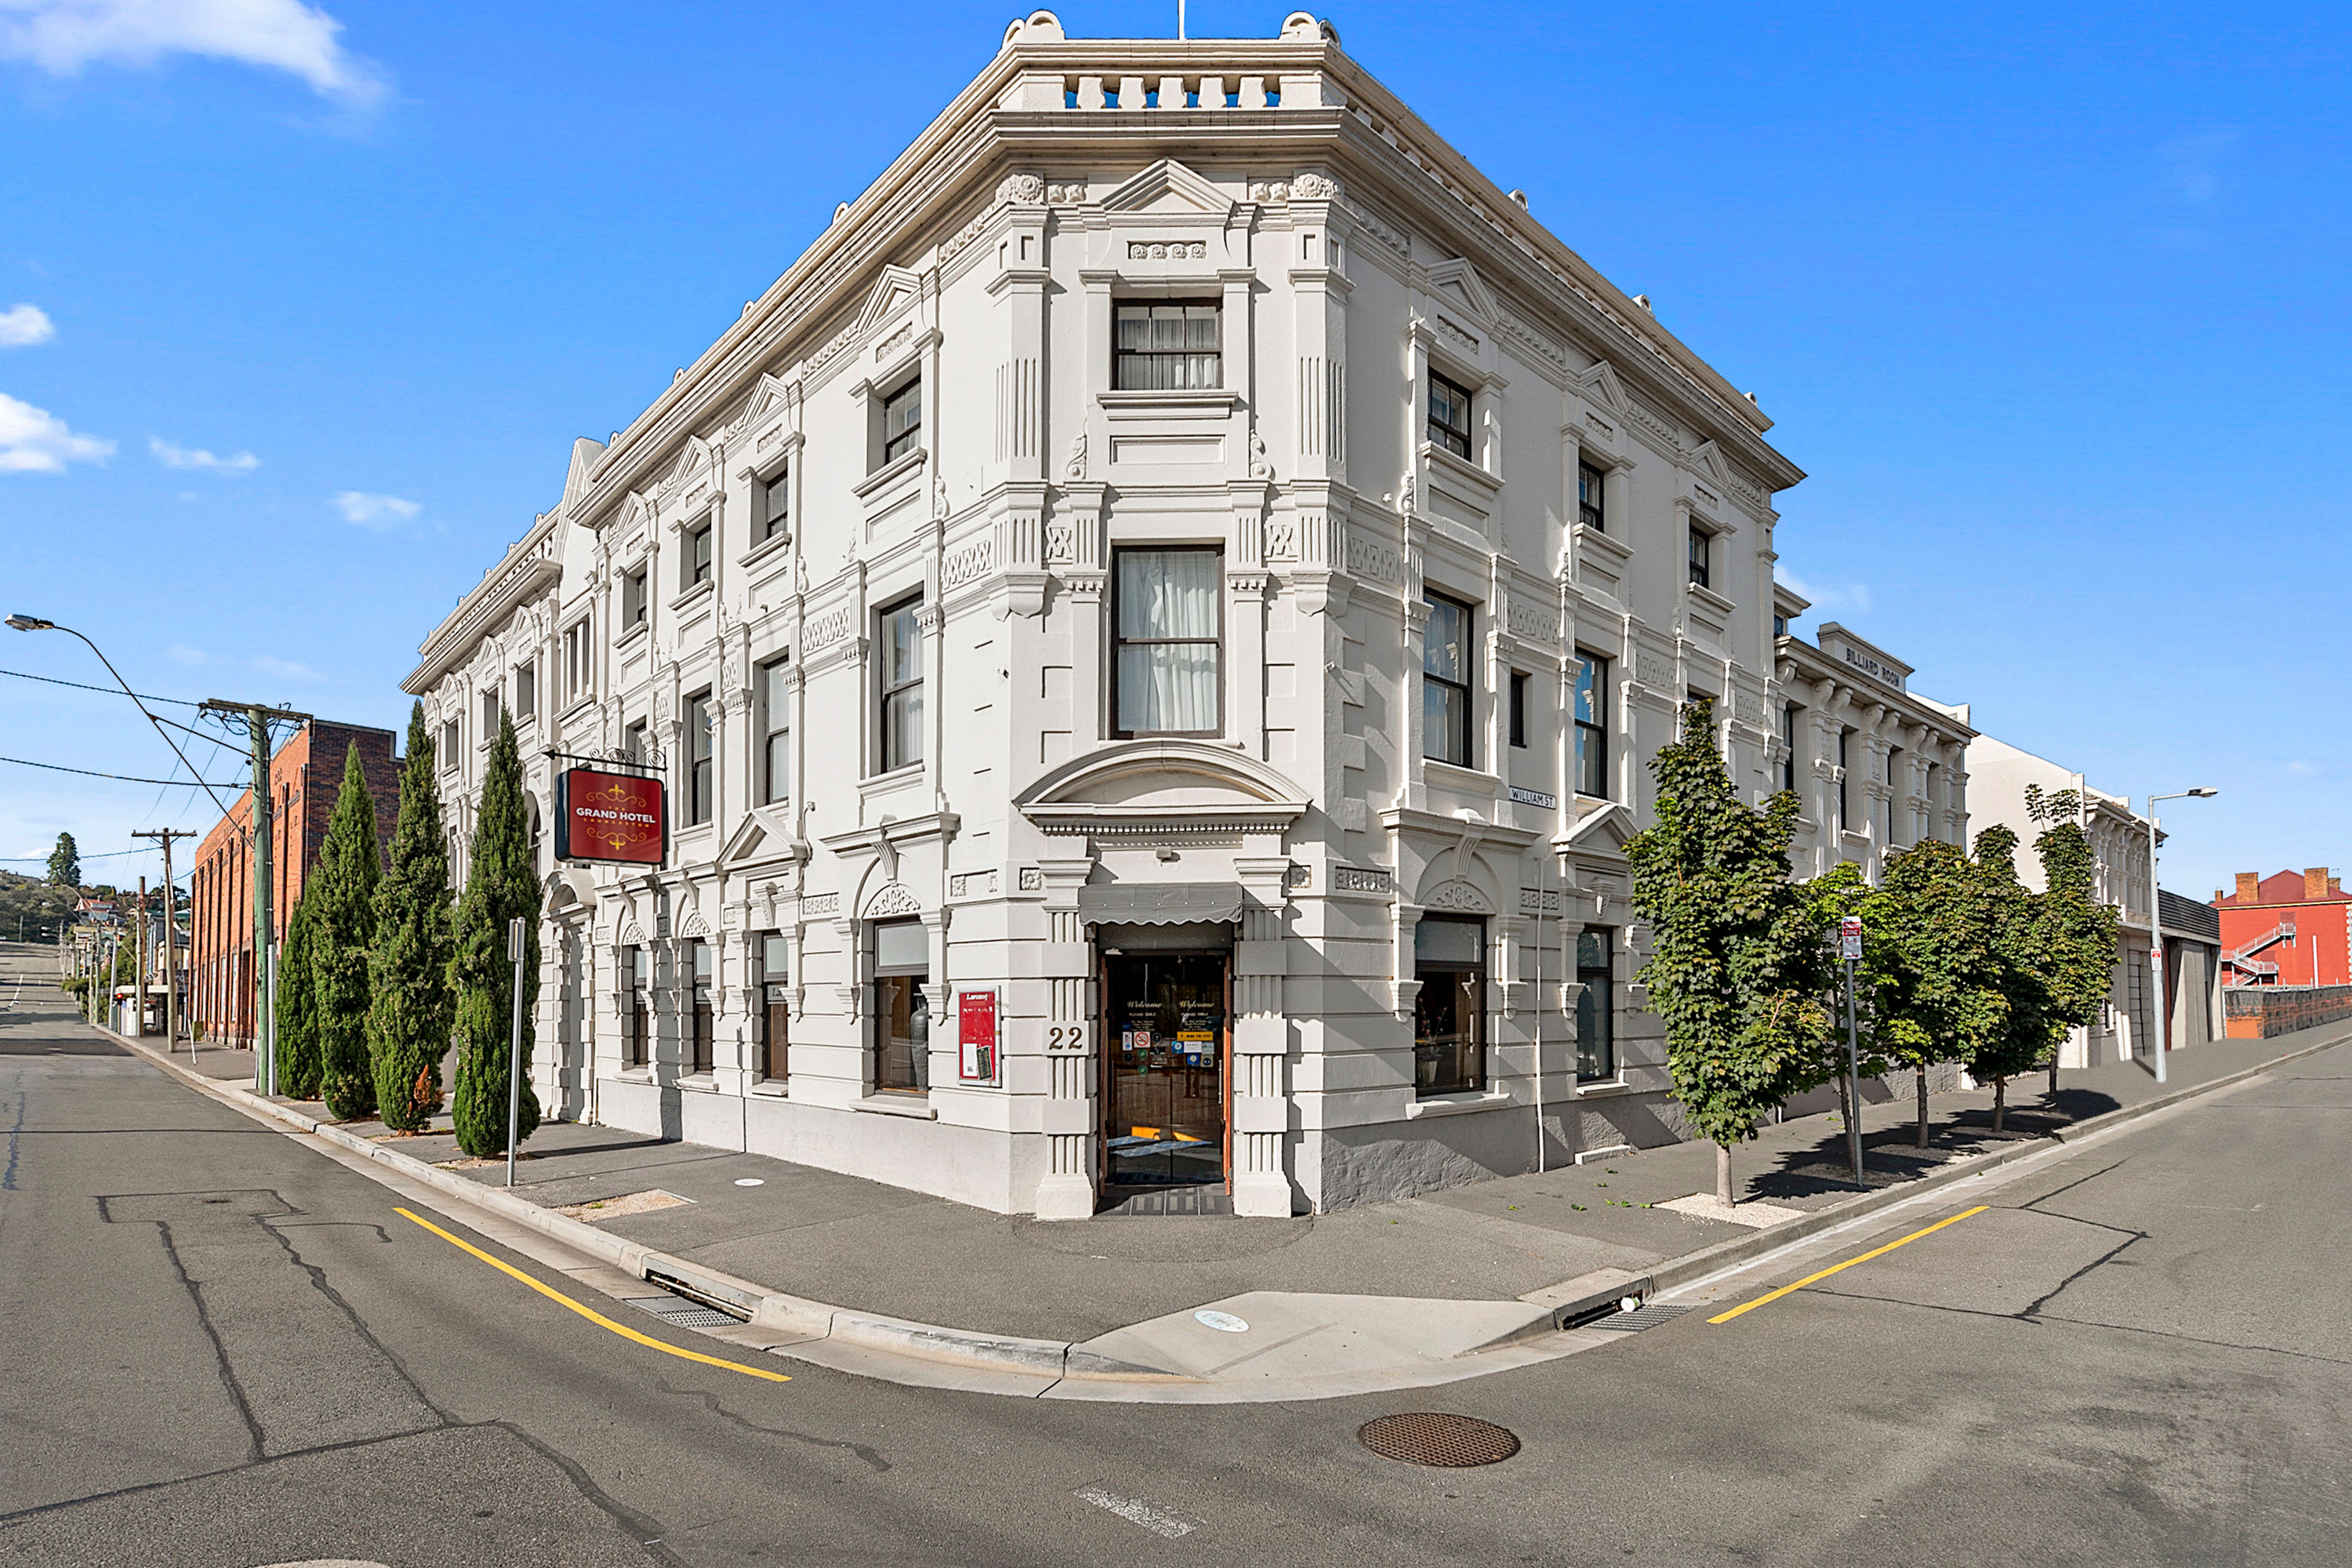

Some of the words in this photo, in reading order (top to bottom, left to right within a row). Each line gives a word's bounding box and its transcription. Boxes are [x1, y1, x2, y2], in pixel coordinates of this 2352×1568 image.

[1846, 648, 1878, 676] BILLIARD
[1882, 666, 1900, 688] ROOM
[1512, 789, 1543, 804] WILLIAM
[575, 807, 617, 819] GRAND
[619, 811, 656, 823] HOTEL
[583, 818, 650, 828] LAUNCESTON
[1049, 1027, 1083, 1050] 22
